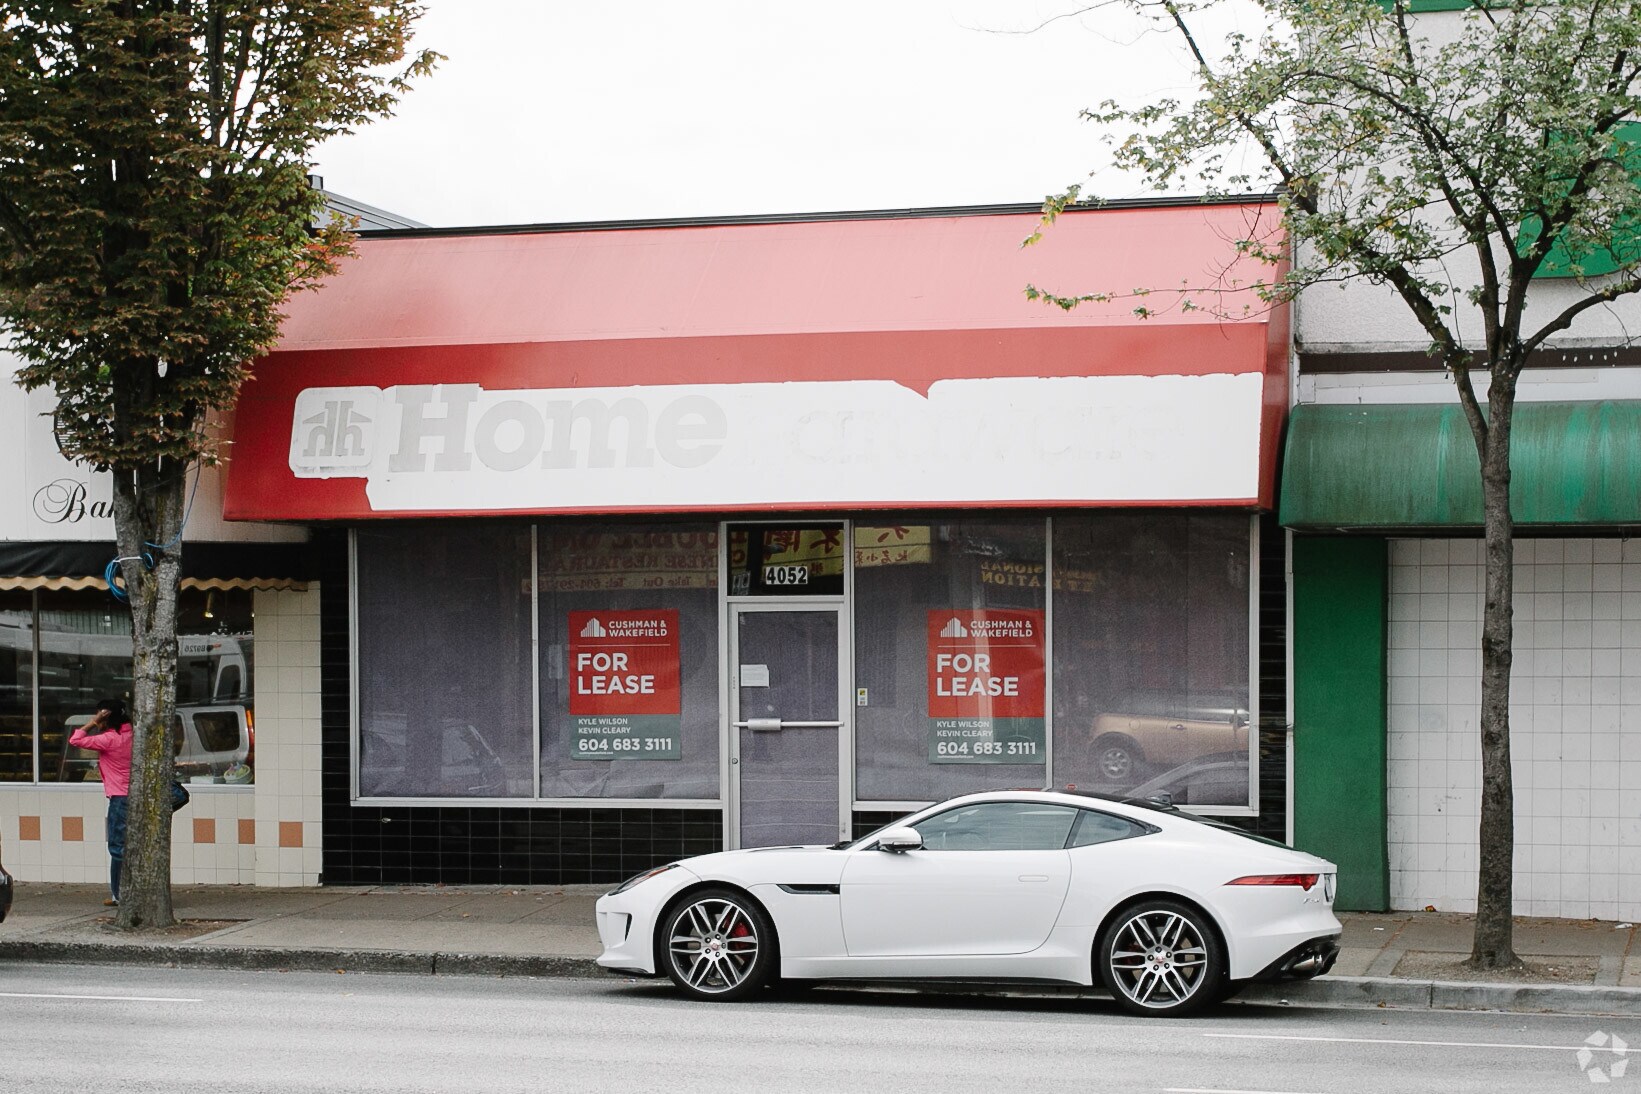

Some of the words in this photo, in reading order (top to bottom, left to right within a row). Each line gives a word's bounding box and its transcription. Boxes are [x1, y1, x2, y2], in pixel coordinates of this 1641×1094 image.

[387, 383, 728, 473] Home
[767, 566, 807, 584] 4052
[609, 620, 657, 628] CUSHMAN
[660, 620, 667, 628] &
[970, 620, 1023, 629] CUSHMAN
[1025, 620, 1032, 629] &
[609, 629, 668, 637] WAKEFIELD
[970, 629, 1033, 638] WAKEFIELD
[577, 653, 628, 671] FOR
[937, 653, 990, 673] FOR
[578, 675, 655, 694] LEASE
[937, 677, 1019, 696] LEASE
[579, 738, 608, 751] 604
[612, 738, 640, 751] 683
[645, 738, 672, 750] 3111
[937, 741, 969, 755] 604
[973, 741, 1003, 755] 683
[1007, 741, 1036, 755] 3111
